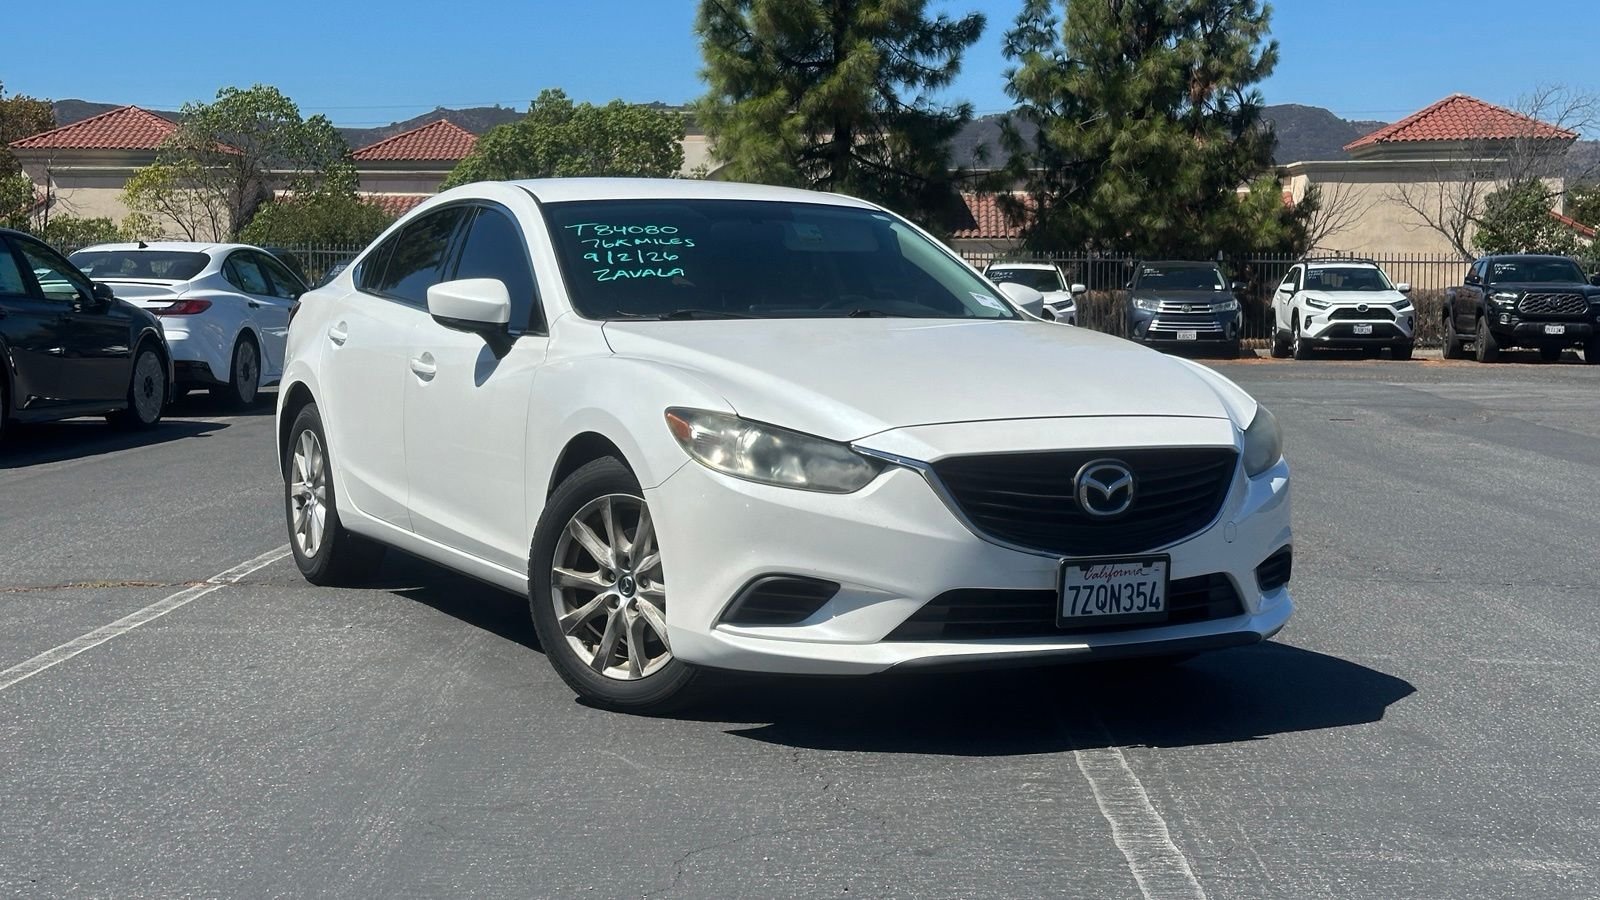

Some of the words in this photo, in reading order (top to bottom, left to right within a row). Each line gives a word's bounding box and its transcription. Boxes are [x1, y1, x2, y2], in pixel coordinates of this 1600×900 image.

[565, 223, 678, 236] T84080
[583, 250, 679, 264] 9/2/26
[593, 268, 685, 282] ZAVALA
[1084, 564, 1150, 583] California
[1068, 581, 1161, 615] 7ZQN354
